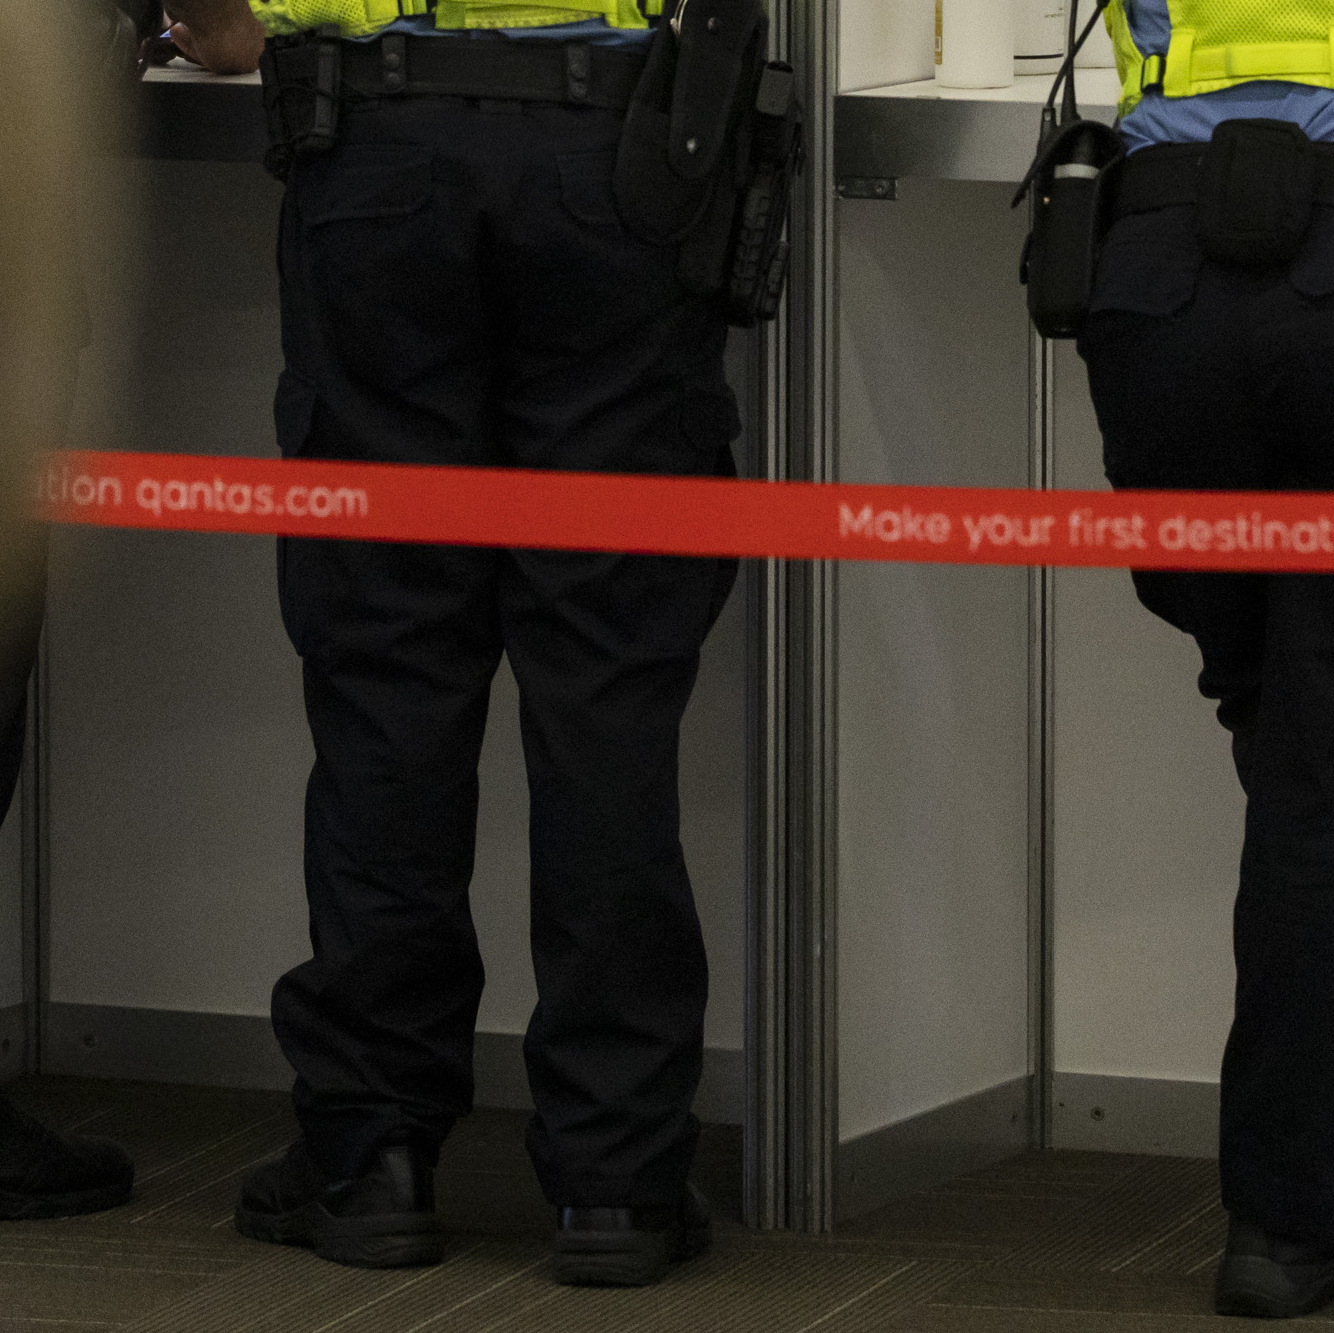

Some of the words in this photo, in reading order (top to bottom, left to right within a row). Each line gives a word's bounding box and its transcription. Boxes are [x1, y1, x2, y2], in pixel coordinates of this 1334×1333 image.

[135, 476, 369, 519] qantas.com
[838, 502, 952, 544] Make
[962, 513, 1056, 554] your
[1068, 506, 1148, 550] first
